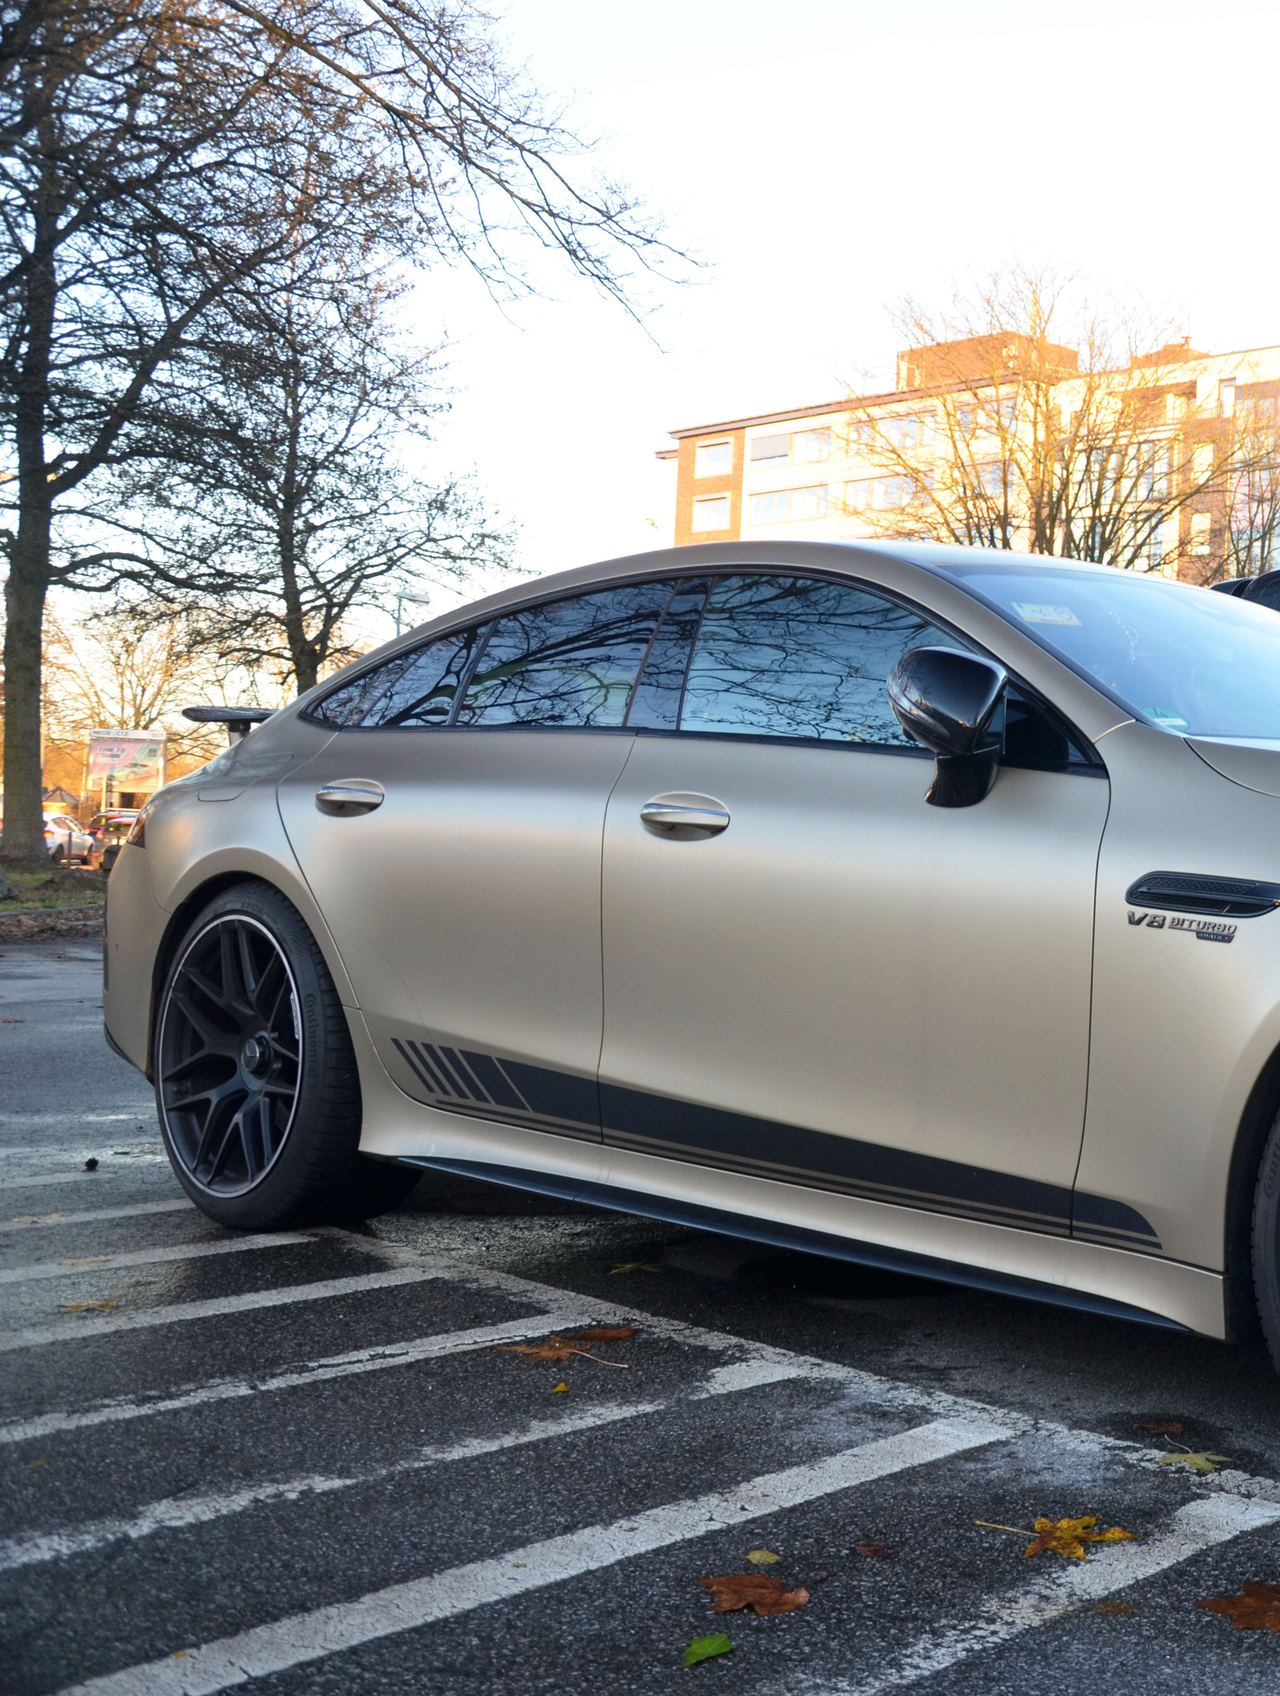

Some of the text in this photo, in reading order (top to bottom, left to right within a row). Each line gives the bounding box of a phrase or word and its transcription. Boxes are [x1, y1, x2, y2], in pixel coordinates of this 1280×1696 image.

[1127, 911, 1237, 935] V8 BITURBO
[303, 992, 320, 1078] Continental
